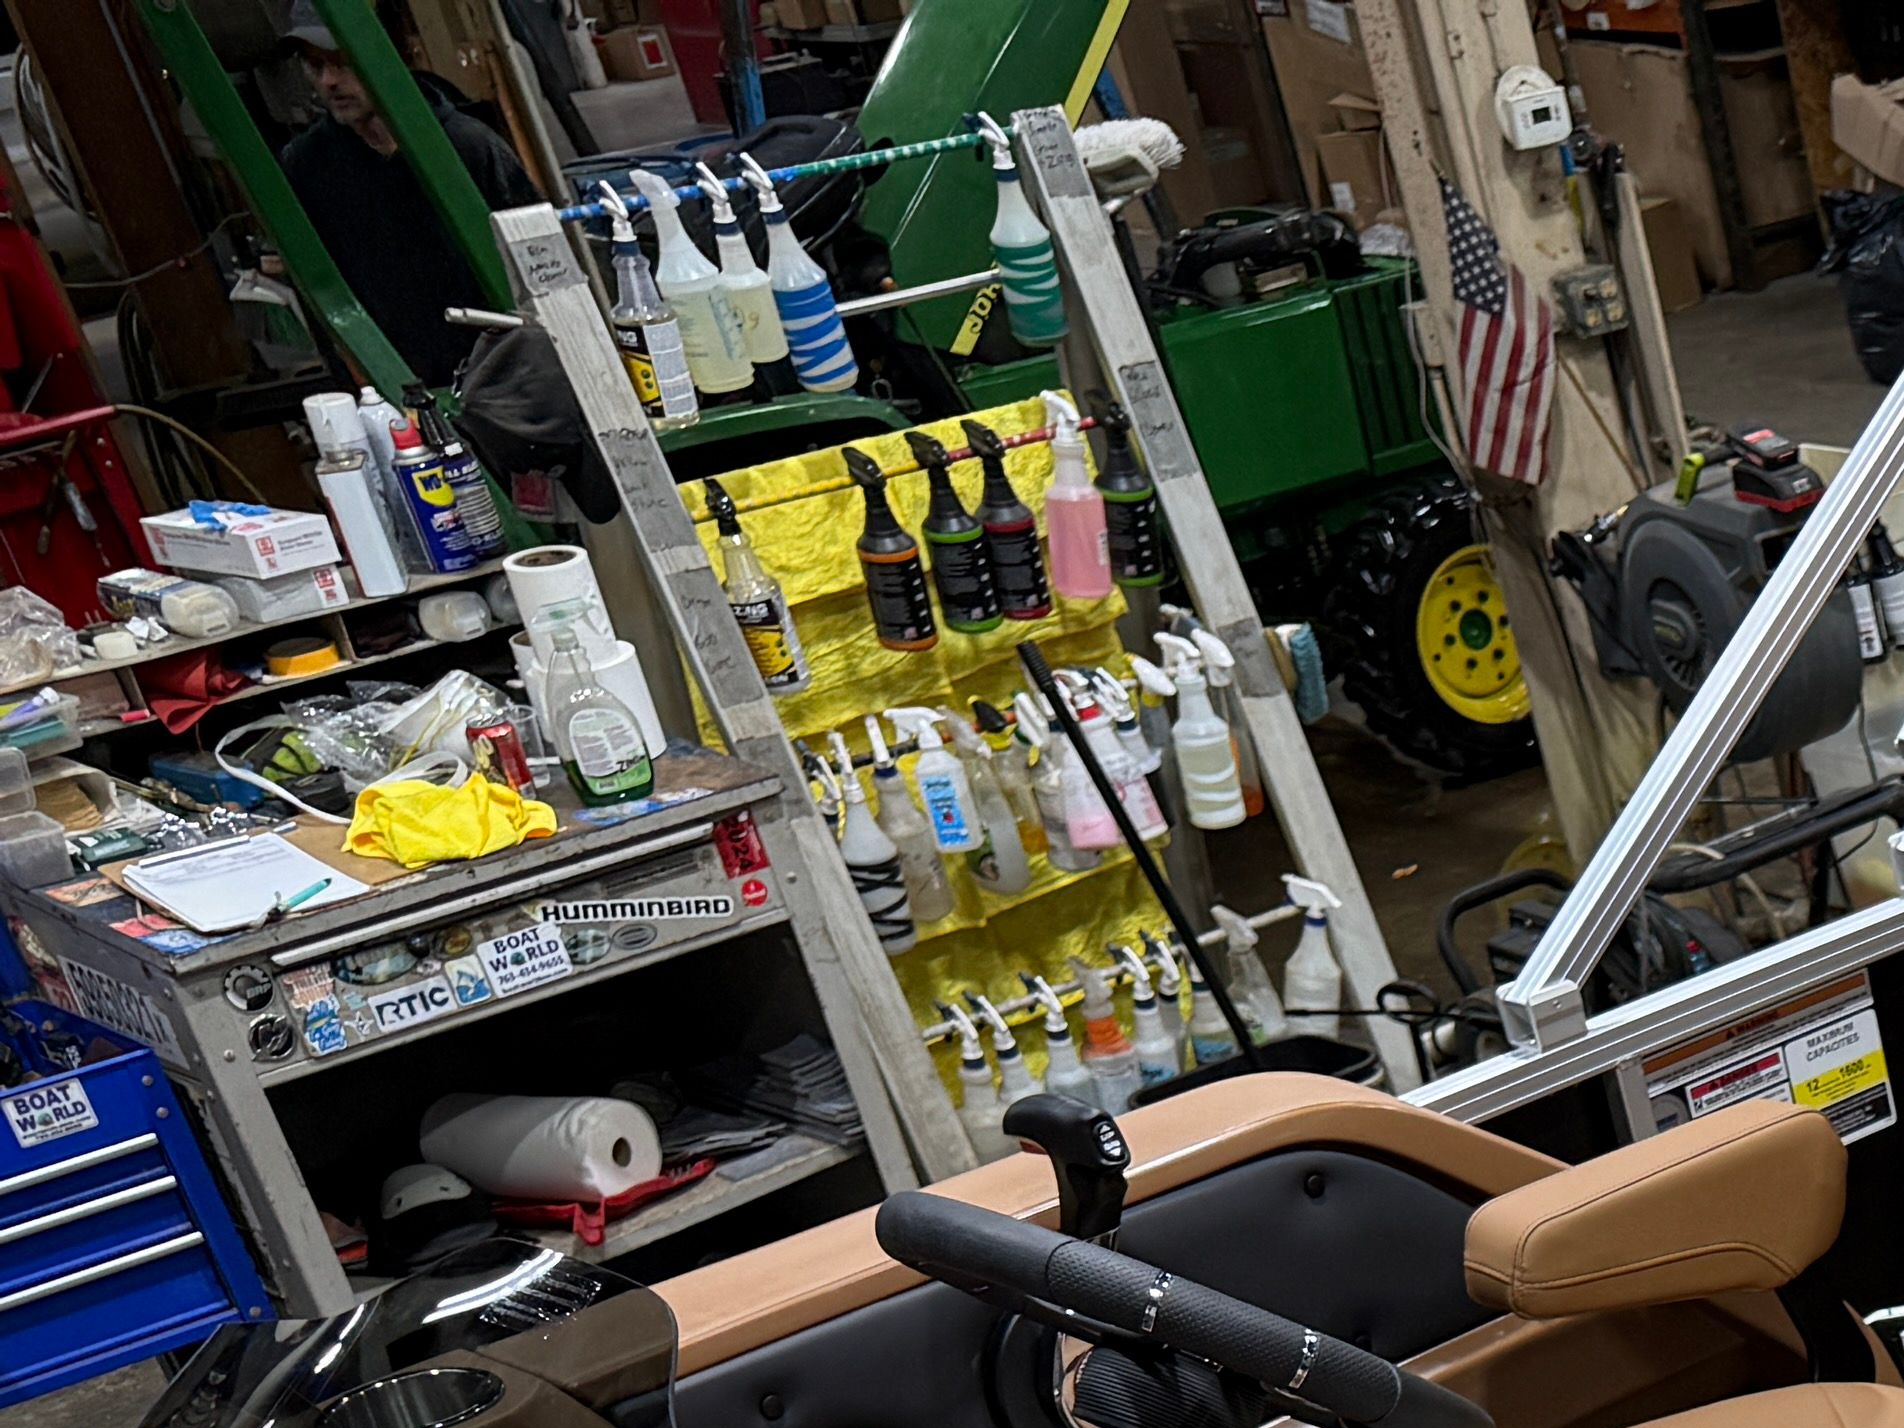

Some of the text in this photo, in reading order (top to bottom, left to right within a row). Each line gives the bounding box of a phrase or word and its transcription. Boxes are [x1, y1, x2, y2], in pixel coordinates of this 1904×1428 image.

[541, 898, 732, 922] HUMMINBIRD
[493, 927, 540, 955] BOAT
[375, 987, 450, 1026] RTIC
[13, 1084, 72, 1115] BOAT
[1807, 1078, 1820, 1093] 12
